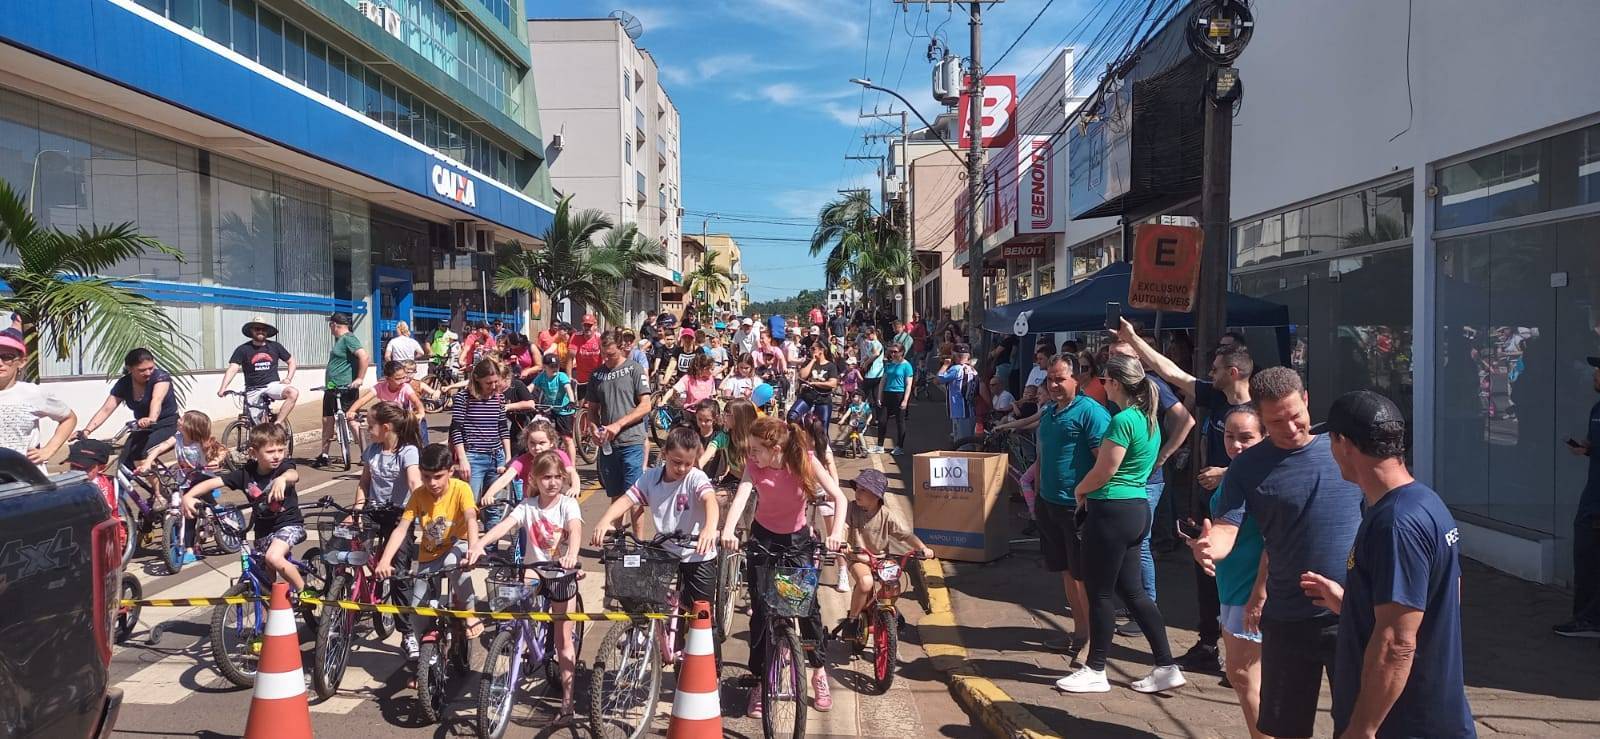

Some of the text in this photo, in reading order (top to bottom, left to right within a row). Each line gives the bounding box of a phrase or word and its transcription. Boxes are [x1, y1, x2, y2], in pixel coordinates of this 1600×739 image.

[962, 85, 1012, 138] B
[432, 164, 476, 208] CAIXA
[1031, 154, 1046, 218] BENOIT
[1004, 245, 1043, 256] BENOIT
[1155, 238, 1178, 266] E
[1137, 281, 1188, 295] EXCLUSIVO
[1131, 293, 1190, 307] AUTOMÓVEIS
[934, 466, 962, 478] LIXO
